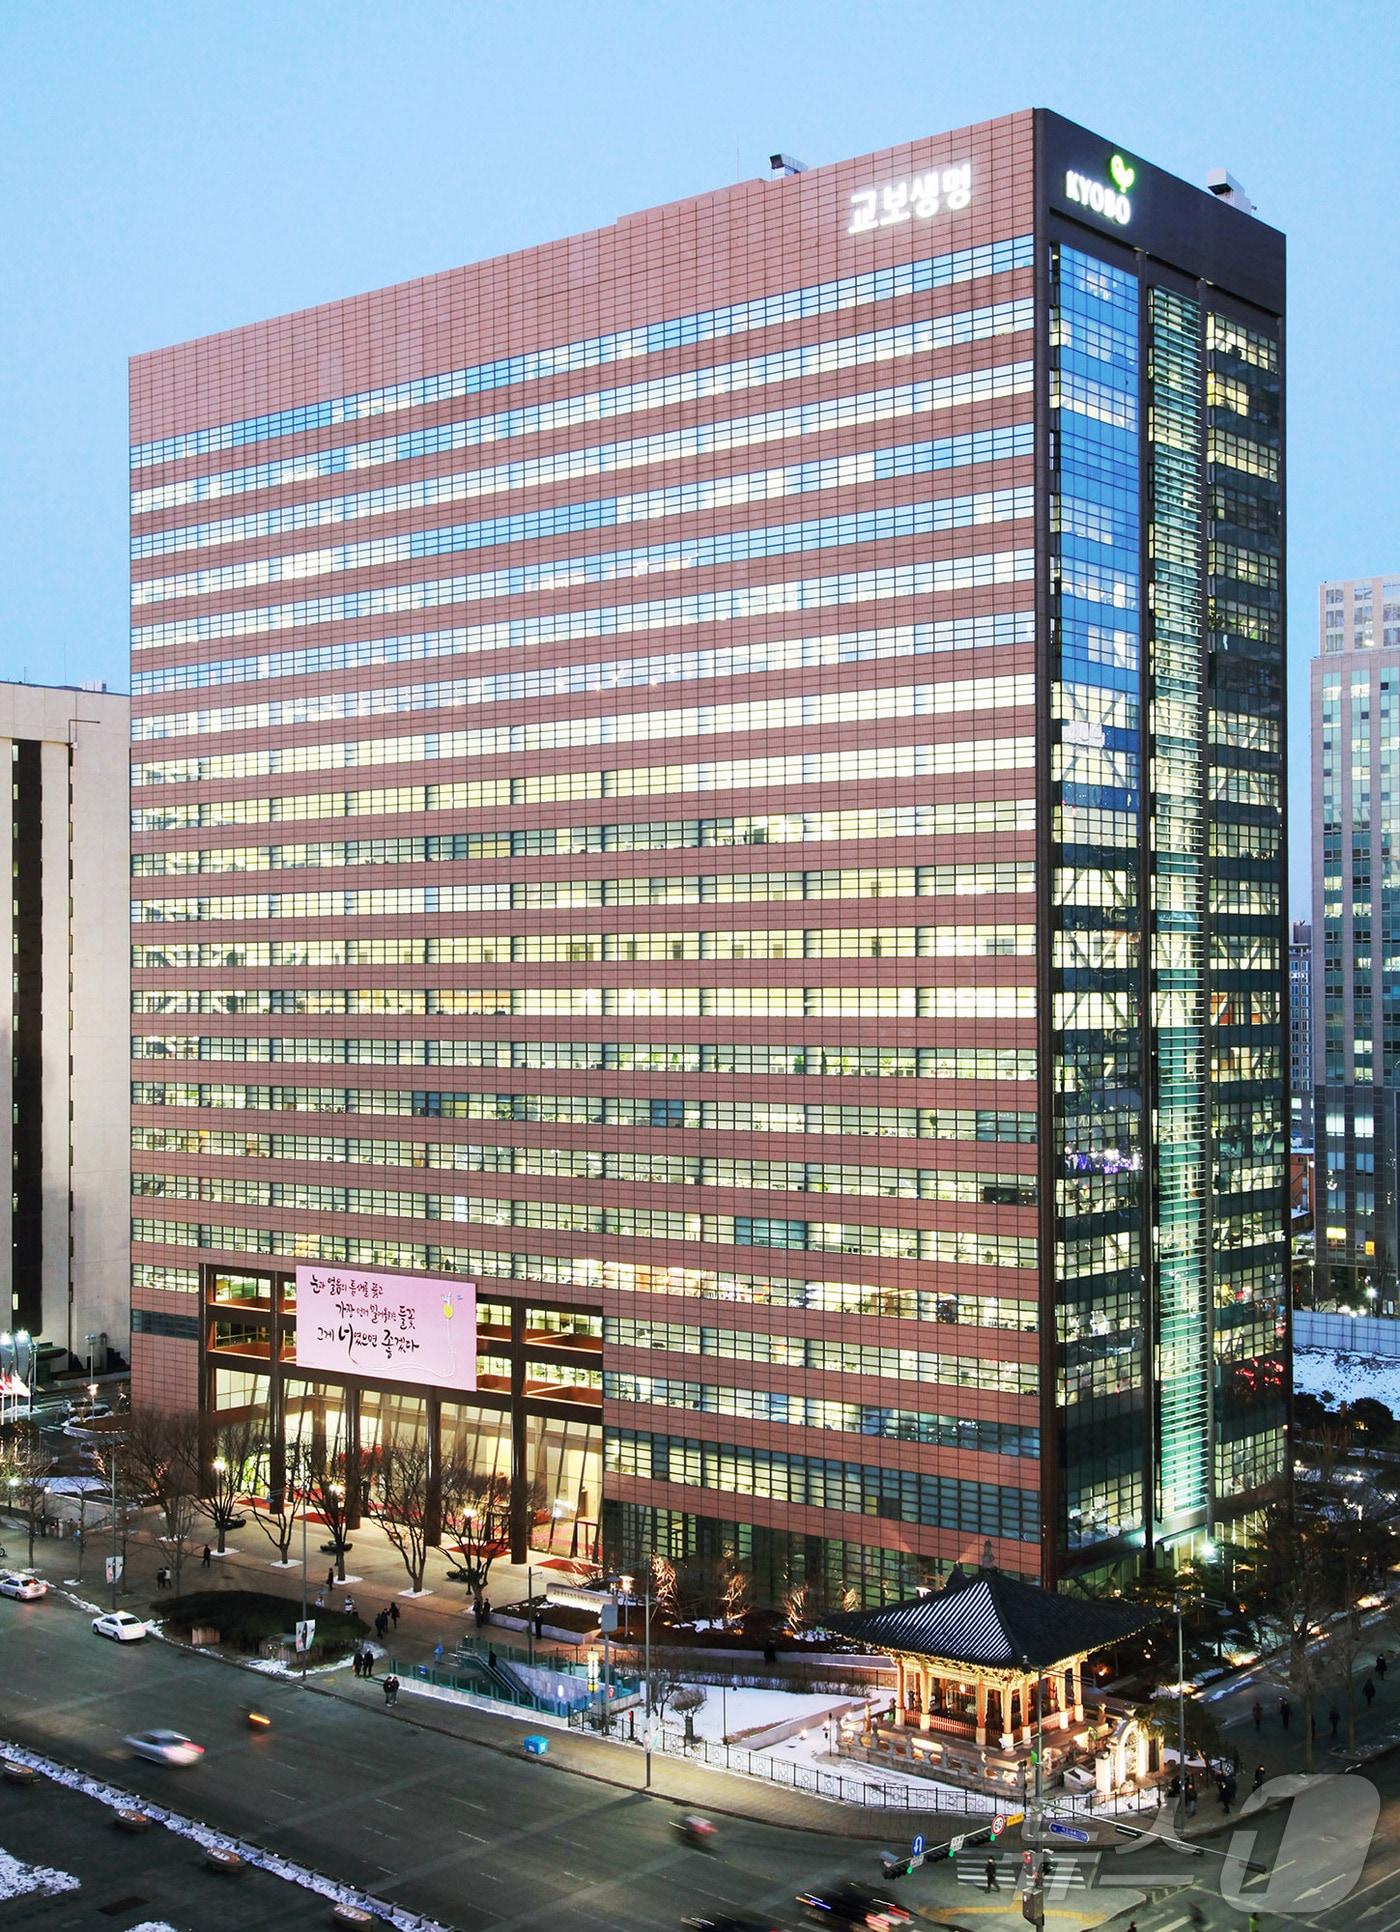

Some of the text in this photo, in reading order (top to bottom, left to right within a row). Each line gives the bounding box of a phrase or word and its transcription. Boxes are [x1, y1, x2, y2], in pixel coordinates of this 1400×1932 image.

[847, 161, 971, 234] 교보생명
[1065, 169, 1131, 225] KYOBO
[310, 1274, 325, 1294] 눈과
[327, 1276, 347, 1296] 얼음의
[335, 1300, 355, 1319] 가장
[398, 1304, 416, 1330] 들꽃
[317, 1327, 335, 1342] 그게
[381, 1329, 420, 1360] 좋겠다
